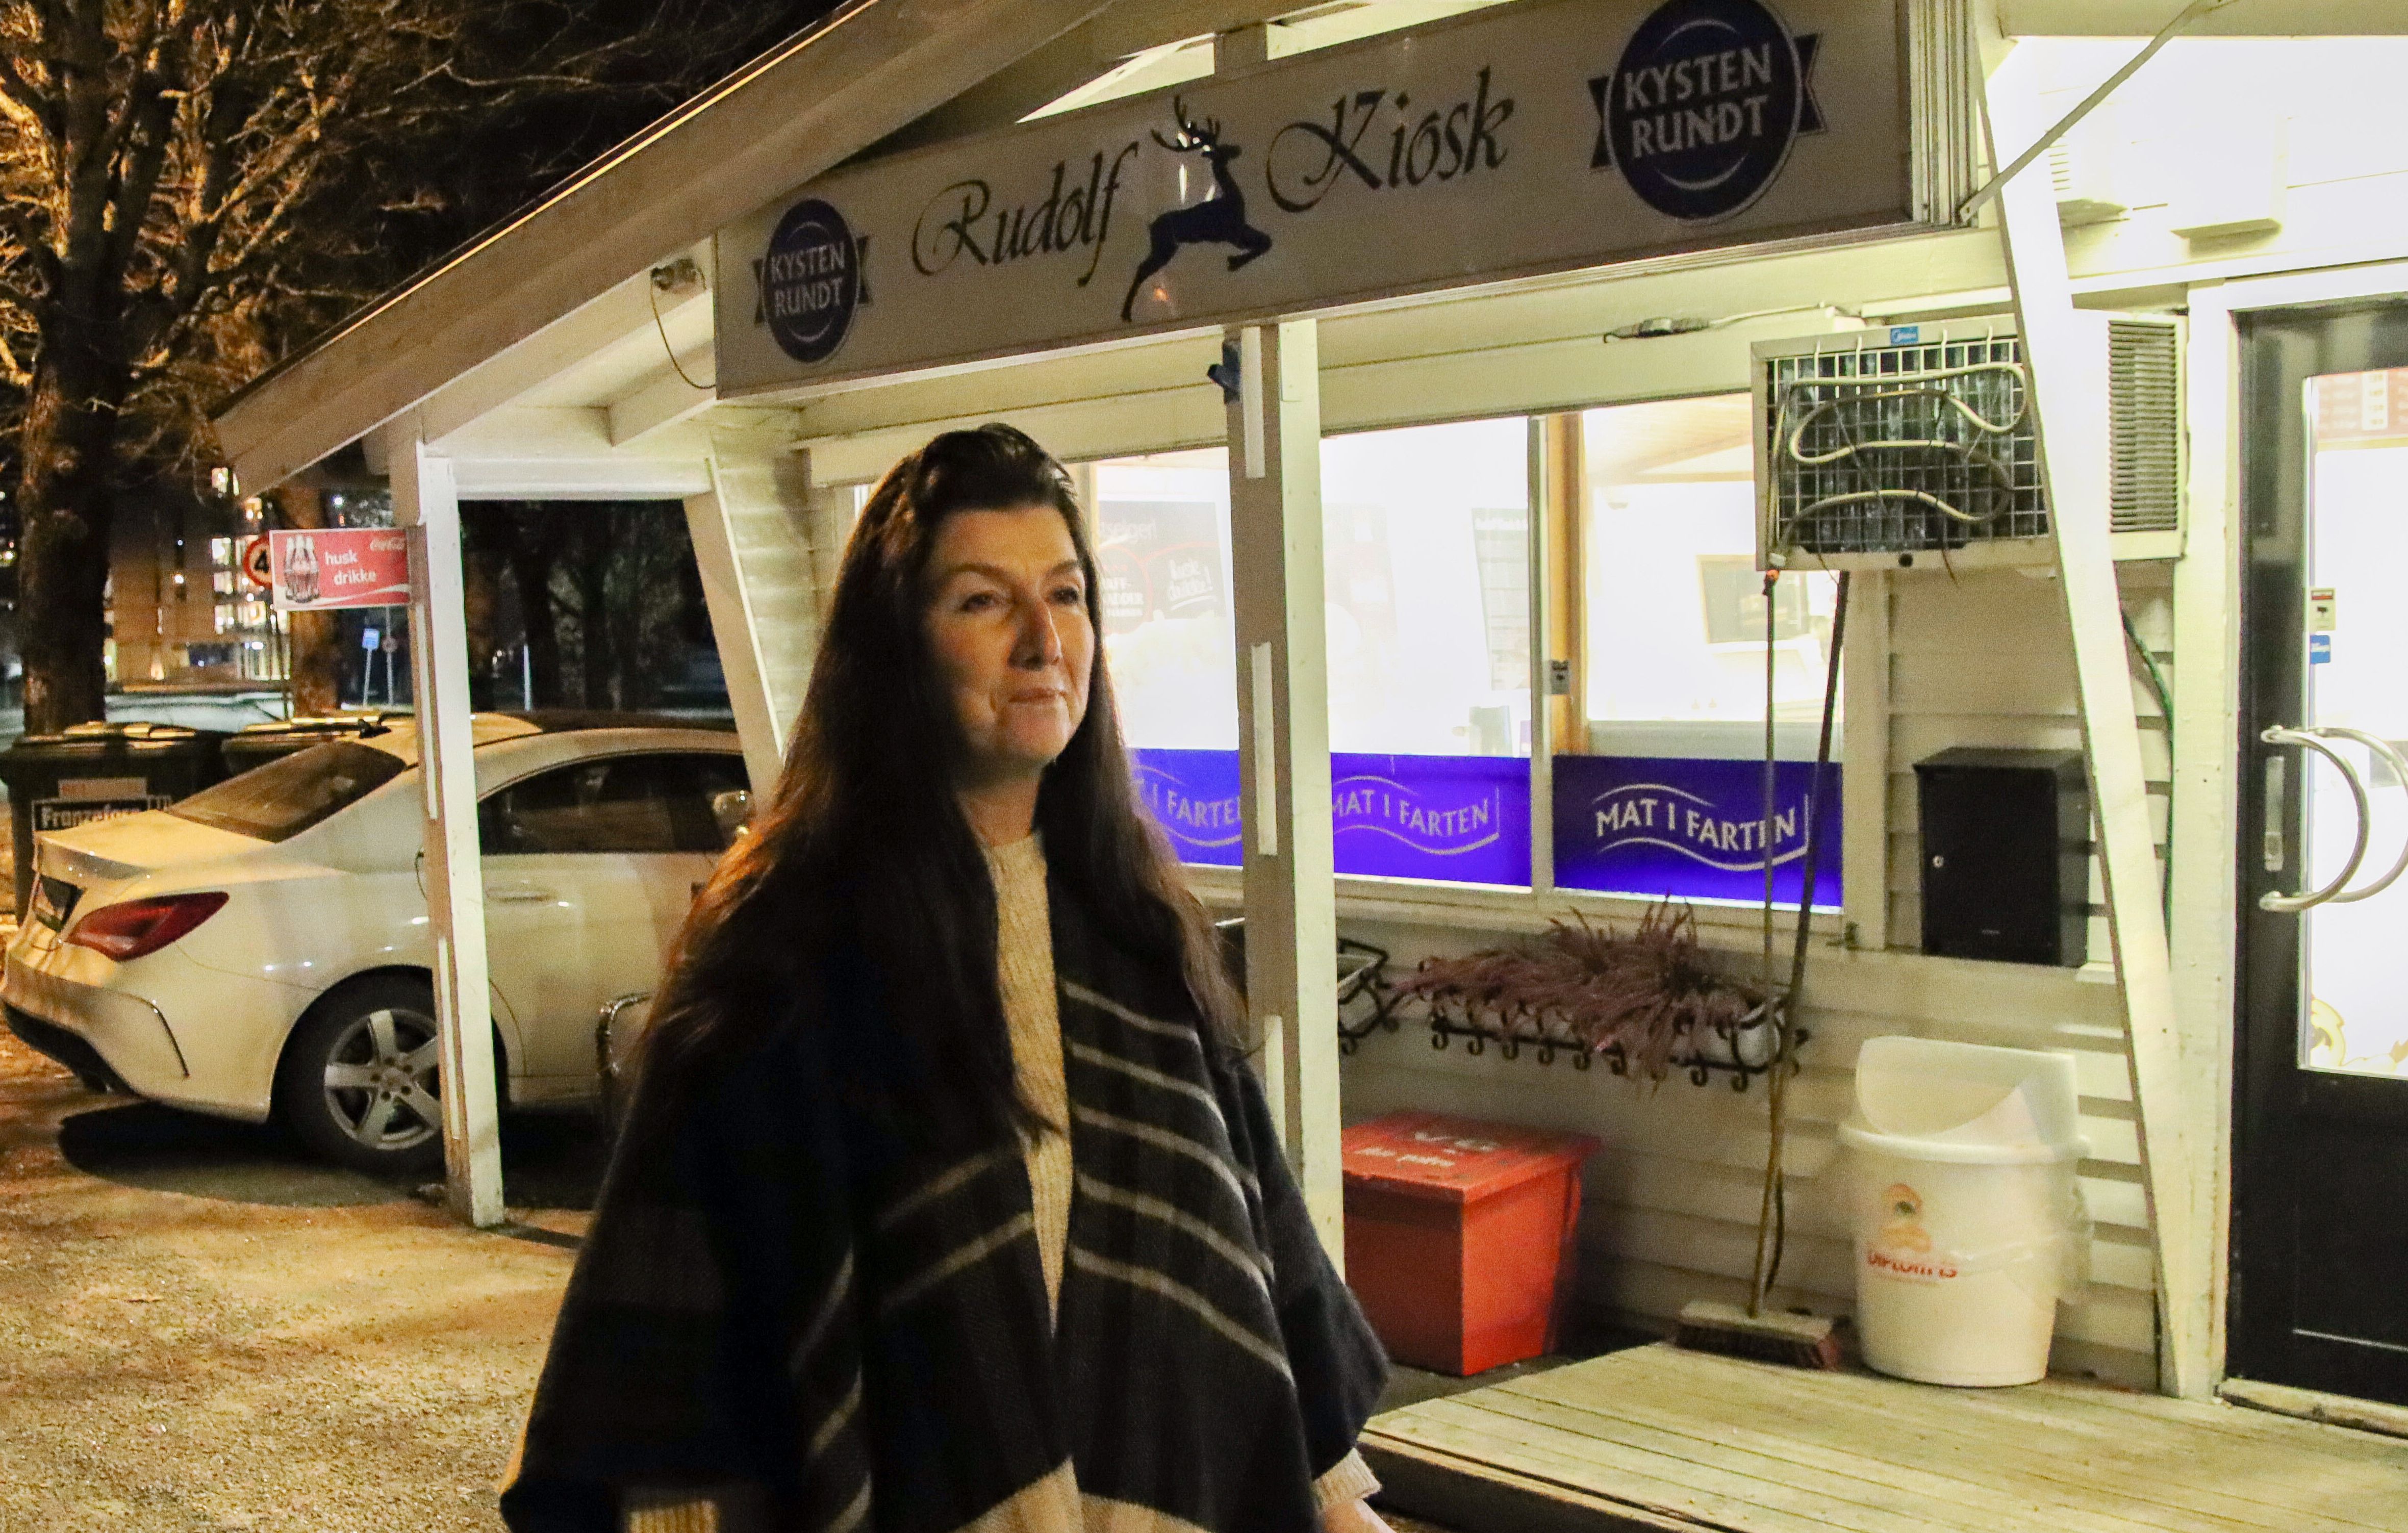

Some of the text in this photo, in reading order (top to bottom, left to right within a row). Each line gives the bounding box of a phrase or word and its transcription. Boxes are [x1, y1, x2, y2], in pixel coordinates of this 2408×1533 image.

[1624, 42, 1771, 111] KYSTEN
[1632, 94, 1769, 159] RUNDT
[911, 65, 1514, 288] Rudolf Kiosk
[770, 241, 845, 284] KYSTEN
[774, 277, 843, 317] RUNDT
[324, 549, 358, 566] husk
[334, 567, 377, 585] drikke
[1383, 793, 1391, 817] I
[1399, 797, 1489, 837] FARTEN
[1595, 798, 1658, 838] MAT
[1667, 802, 1676, 831] I
